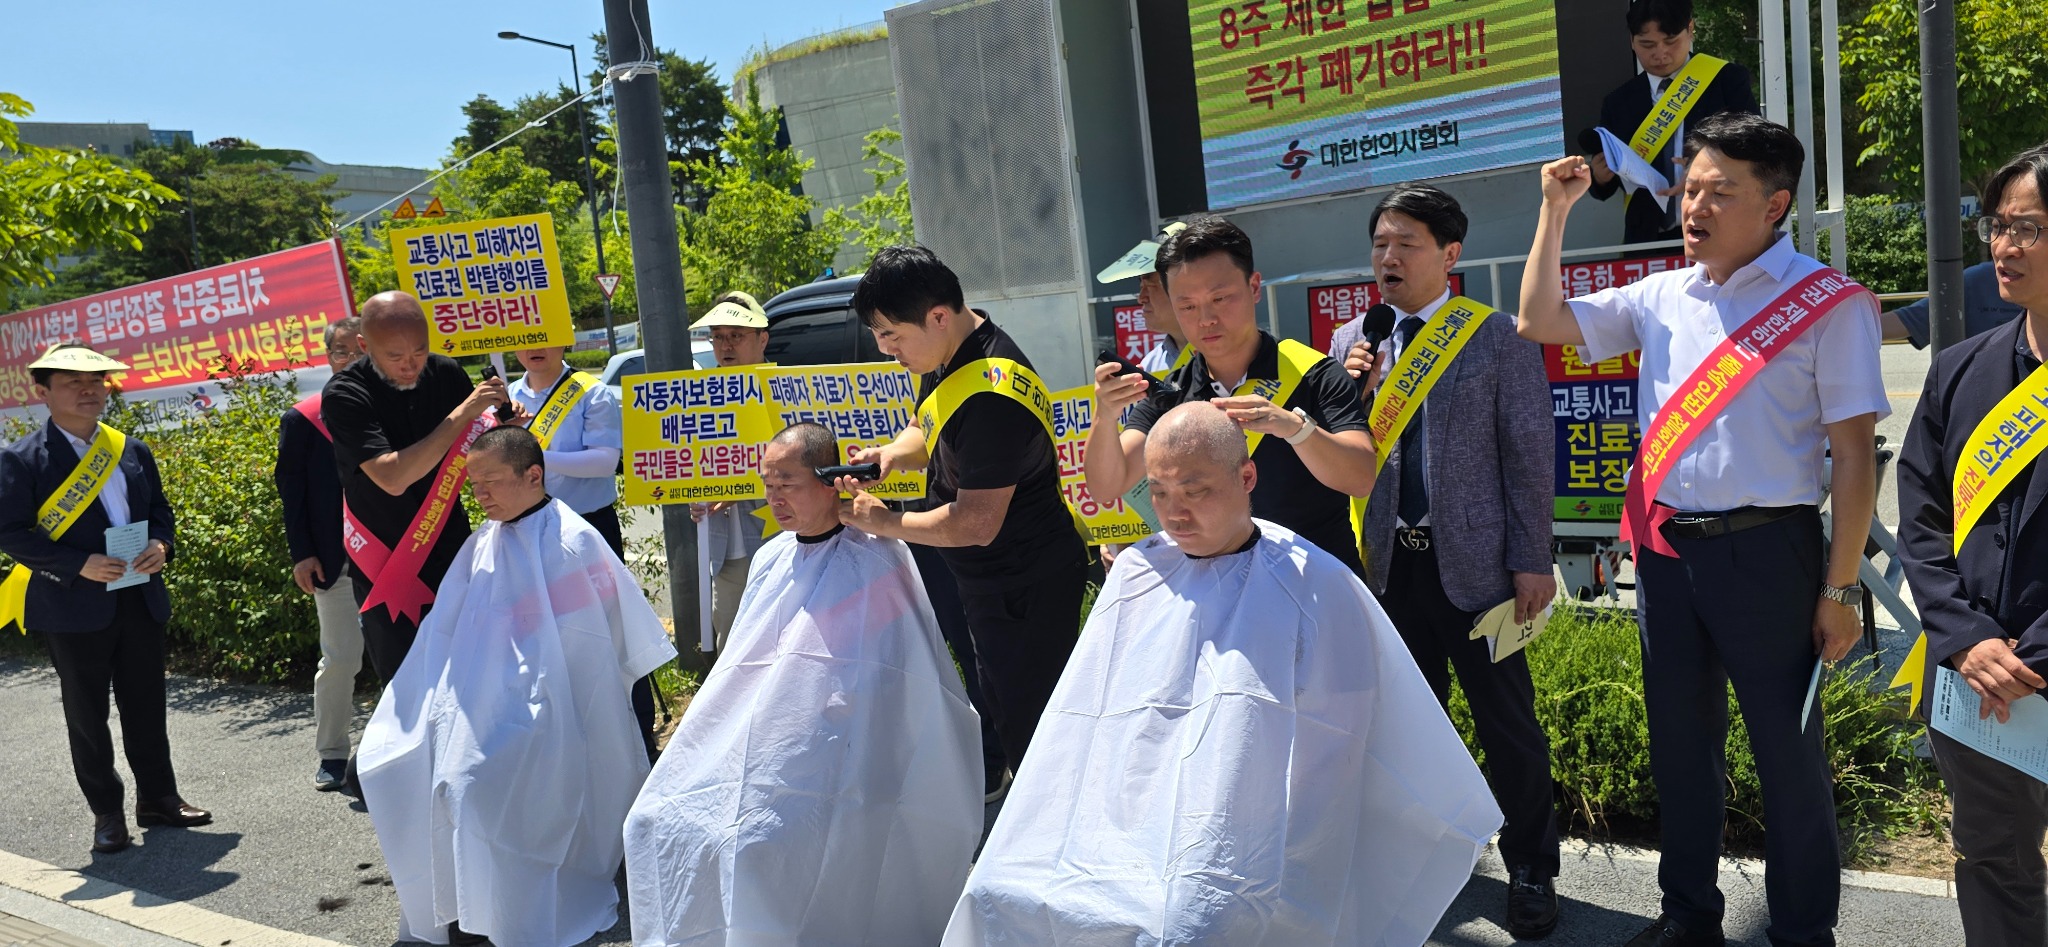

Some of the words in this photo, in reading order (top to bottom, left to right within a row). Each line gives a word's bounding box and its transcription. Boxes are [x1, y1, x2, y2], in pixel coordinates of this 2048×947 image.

[1219, 1, 1272, 49] 8주
[1245, 56, 1307, 109] 즉각
[1319, 19, 1487, 95] 폐기하라!!
[1667, 76, 1700, 112] 보험사는
[1320, 120, 1459, 168] 대한한의사협회
[1640, 109, 1676, 146] 배부르고
[406, 233, 472, 266] 교통사고
[474, 223, 543, 260] 피해자의
[413, 267, 463, 300] 진료권
[465, 258, 549, 296] 박탈행위를
[434, 294, 541, 334] 중단하라!
[1116, 309, 1148, 332] 억울
[1318, 286, 1371, 320] 억울한
[473, 332, 548, 349] 대한한의사협회
[1427, 306, 1474, 351] 교통사고
[1734, 301, 1809, 361] 제한하는
[768, 376, 811, 407] 피해자
[812, 374, 855, 405] 치료가
[857, 372, 915, 404] 우선이지
[1395, 346, 1440, 398] 피해자의
[1680, 353, 1744, 420] 졸속입법
[633, 374, 763, 412] 자동차보험회사
[1553, 385, 1633, 420] 교통사고
[661, 413, 737, 444] 배부르고
[1052, 399, 1092, 438] 통사고
[1567, 422, 1641, 456] 진료
[1641, 410, 1690, 482] 철회하라!
[1973, 405, 2047, 477] 피해자의
[633, 449, 693, 480] 국민들은
[681, 482, 755, 498] 대한한의사협회
[1953, 465, 1987, 531] 진료권
[1092, 521, 1151, 539] 대한한의사협
